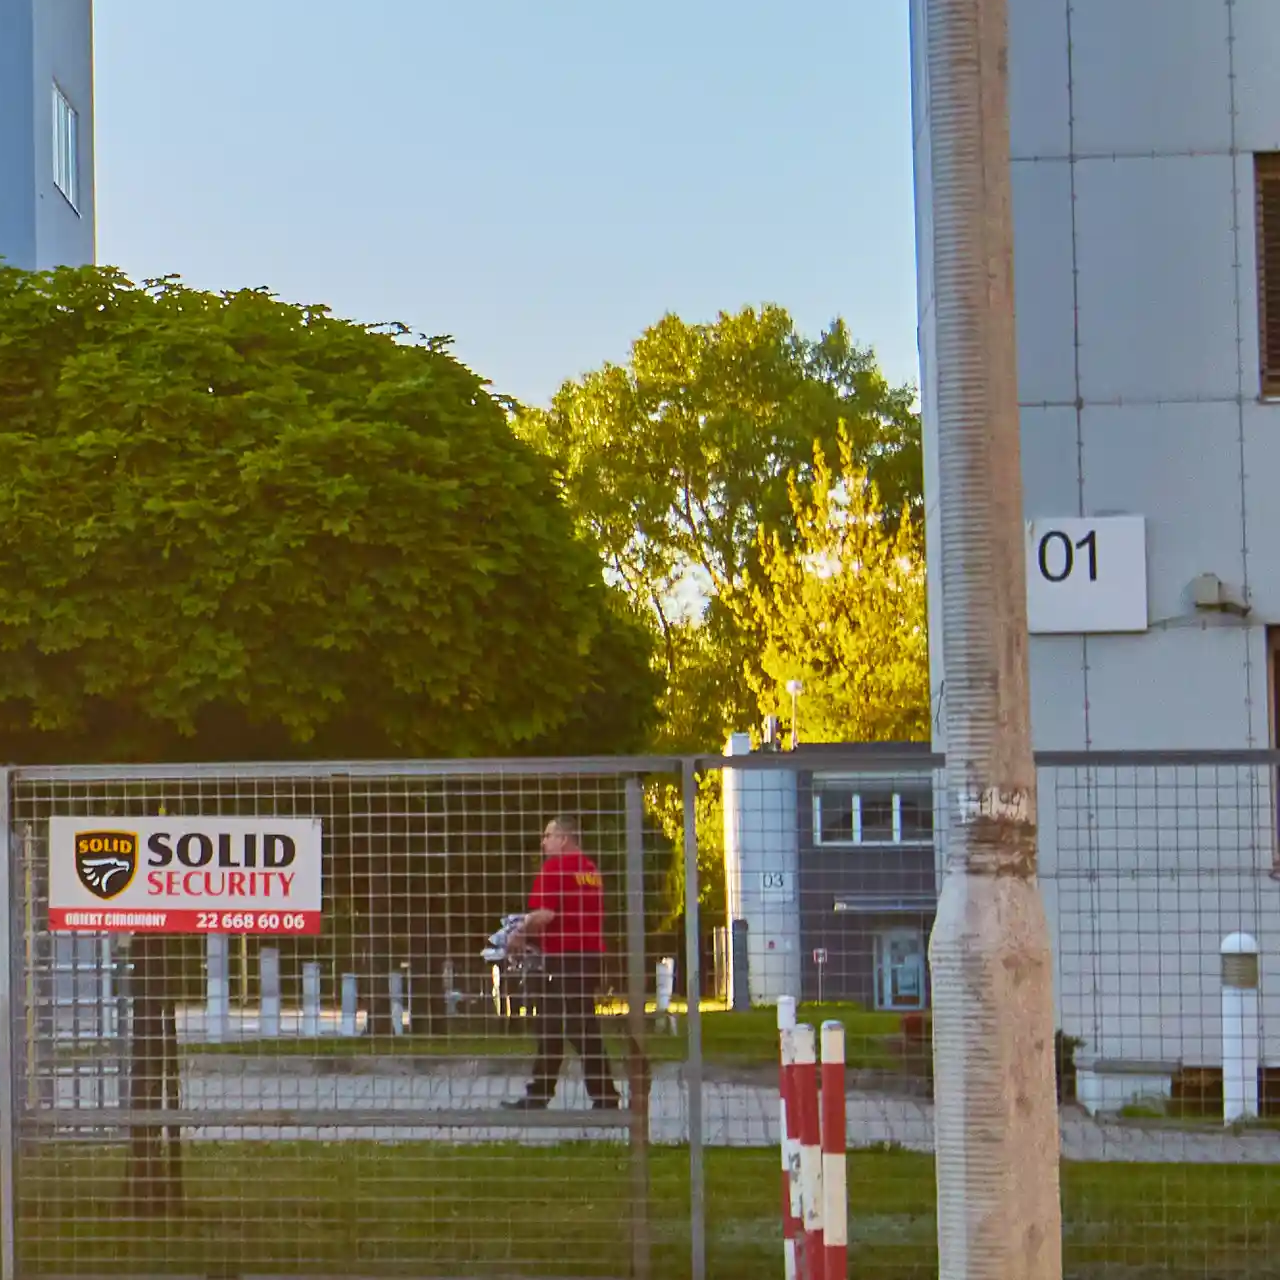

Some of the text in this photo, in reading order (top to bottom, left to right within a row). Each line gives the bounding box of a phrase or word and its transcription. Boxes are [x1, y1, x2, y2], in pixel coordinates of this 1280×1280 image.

[1038, 530, 1097, 582] 01
[79, 838, 132, 853] SOLID
[147, 833, 296, 868] SOLID
[147, 871, 296, 897] SECURITY
[762, 873, 784, 889] 03
[196, 913, 218, 929] 22
[222, 913, 254, 929] 668
[258, 914, 279, 930] 60
[283, 914, 305, 930] 06
